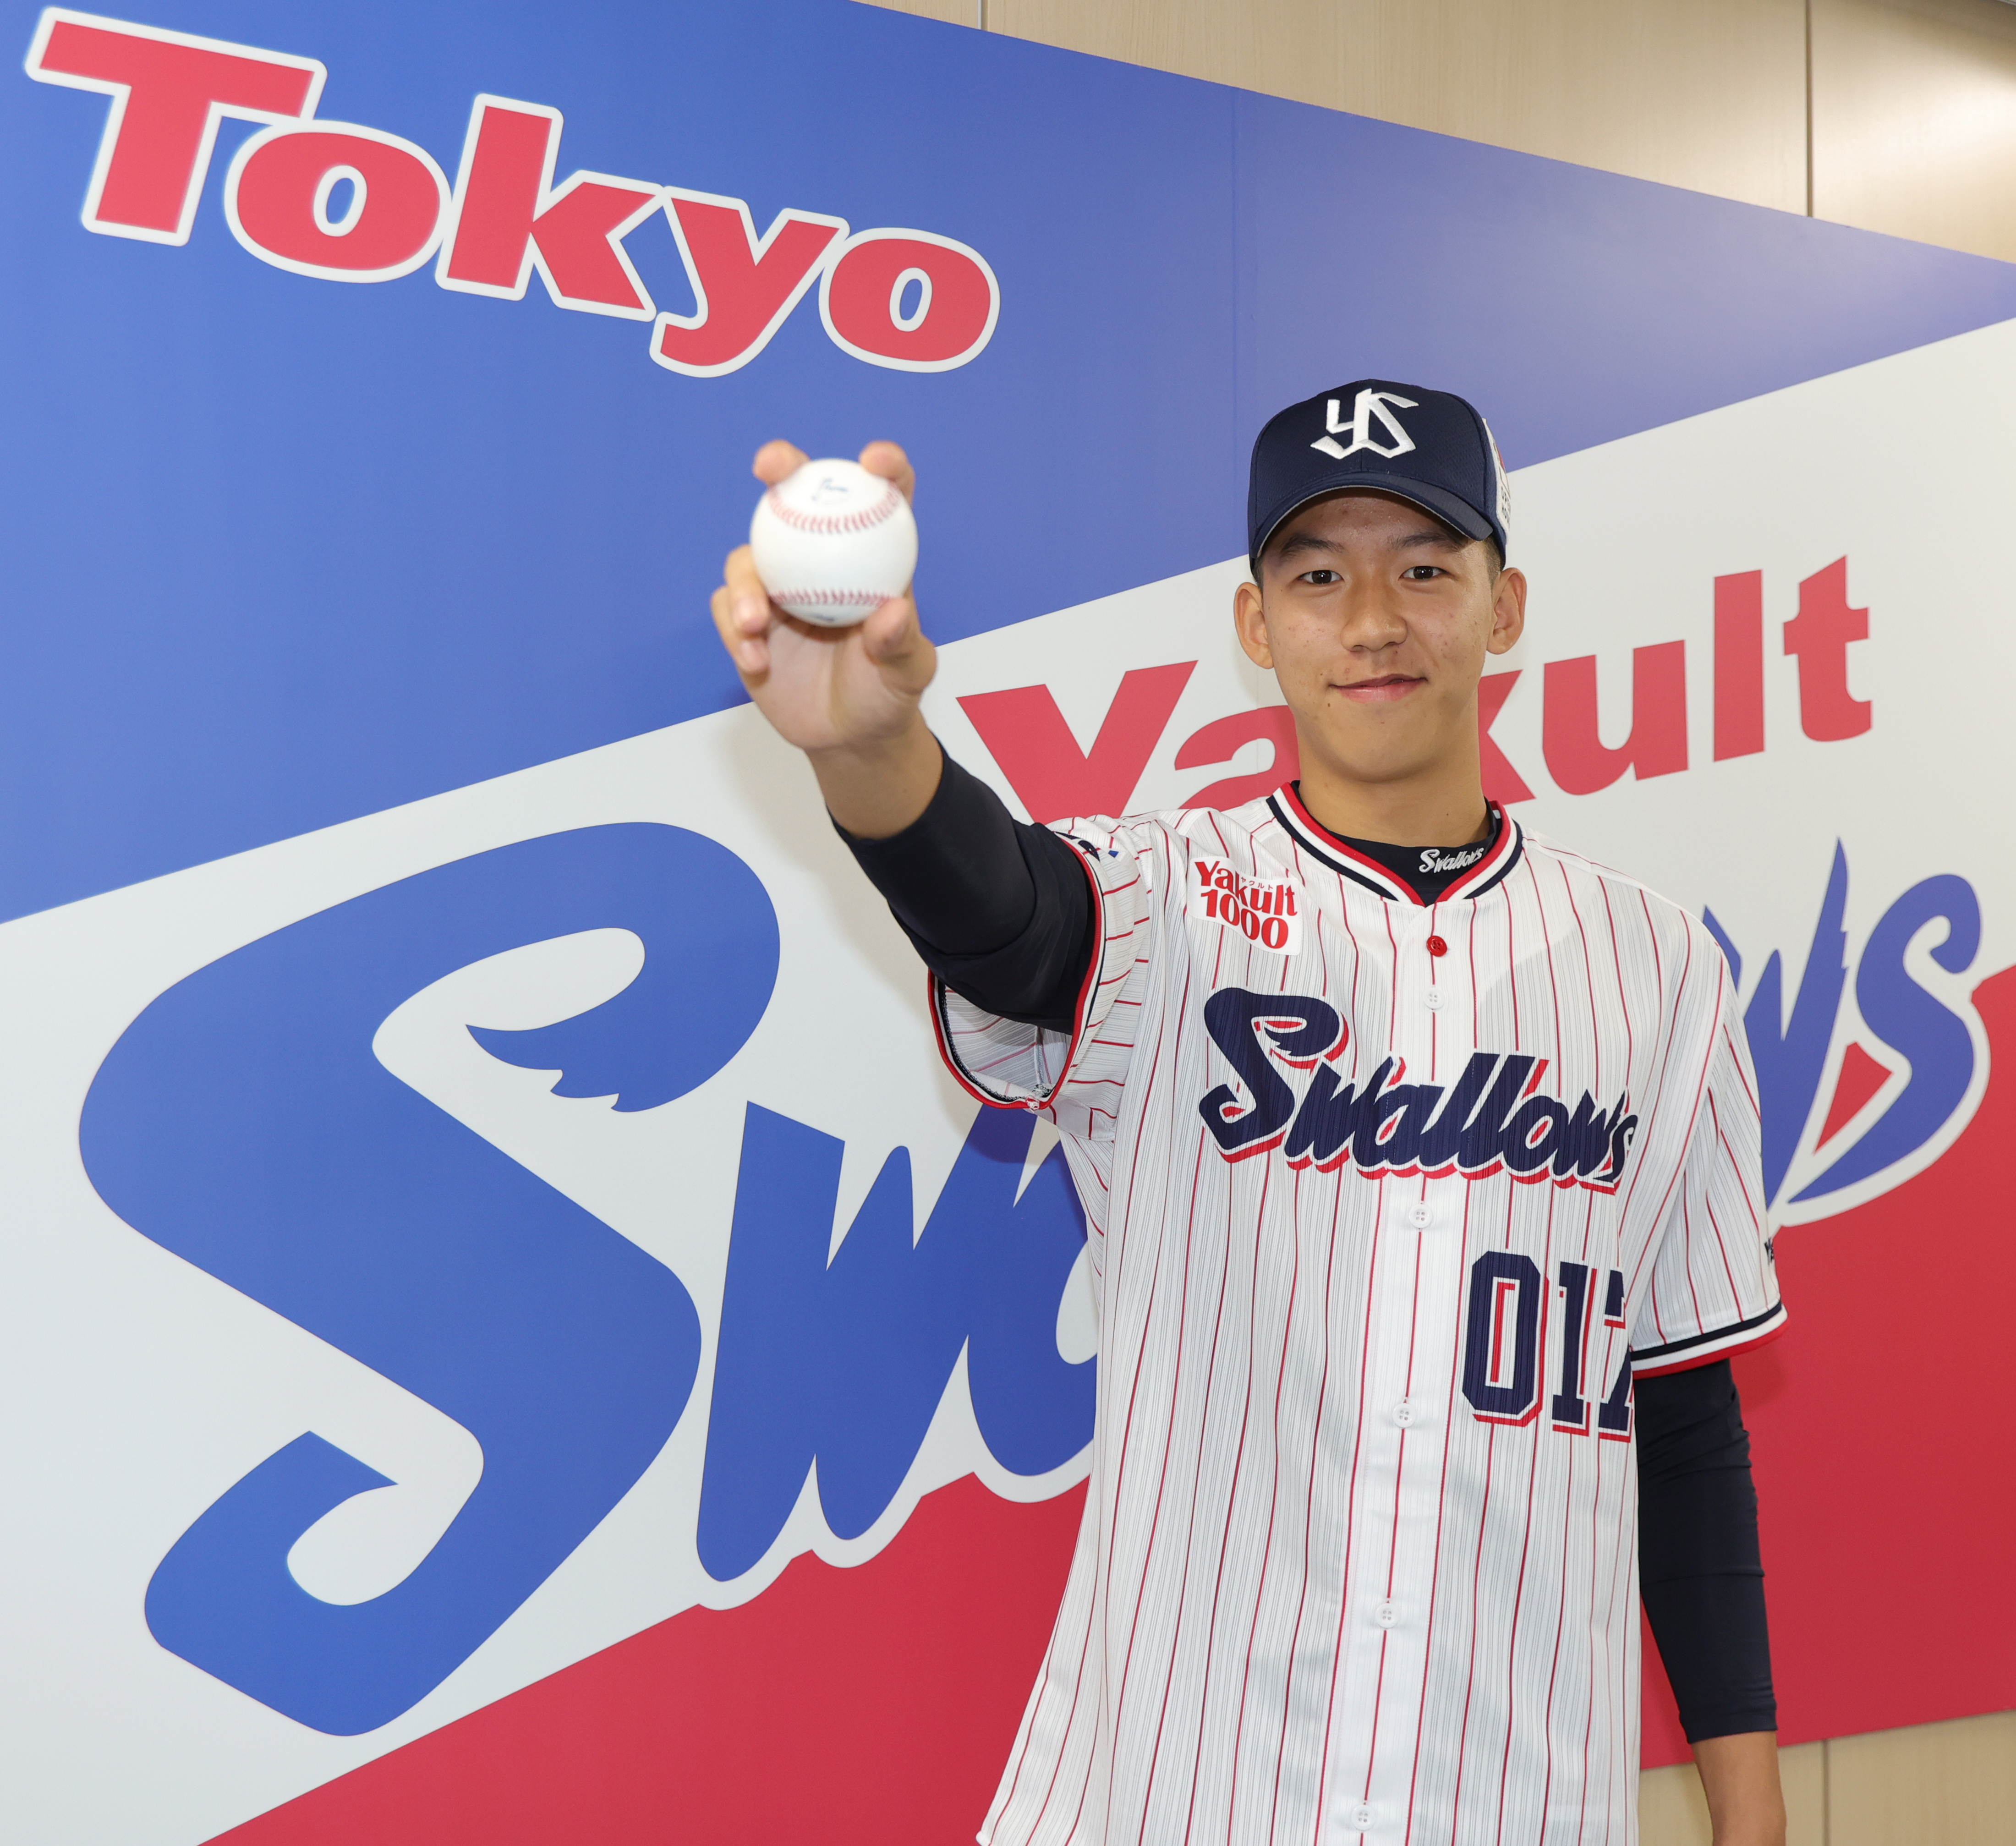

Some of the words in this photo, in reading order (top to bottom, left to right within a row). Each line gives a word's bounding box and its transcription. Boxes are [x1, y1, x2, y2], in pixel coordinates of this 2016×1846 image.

[25, 7, 1000, 378] Tokyo
[1194, 861, 1298, 916] Yakult
[1240, 877, 1274, 891] ヤクルト
[1419, 848, 1484, 873] Swallows
[1200, 889, 1288, 949] 1000
[1199, 987, 1638, 1195] Swallows
